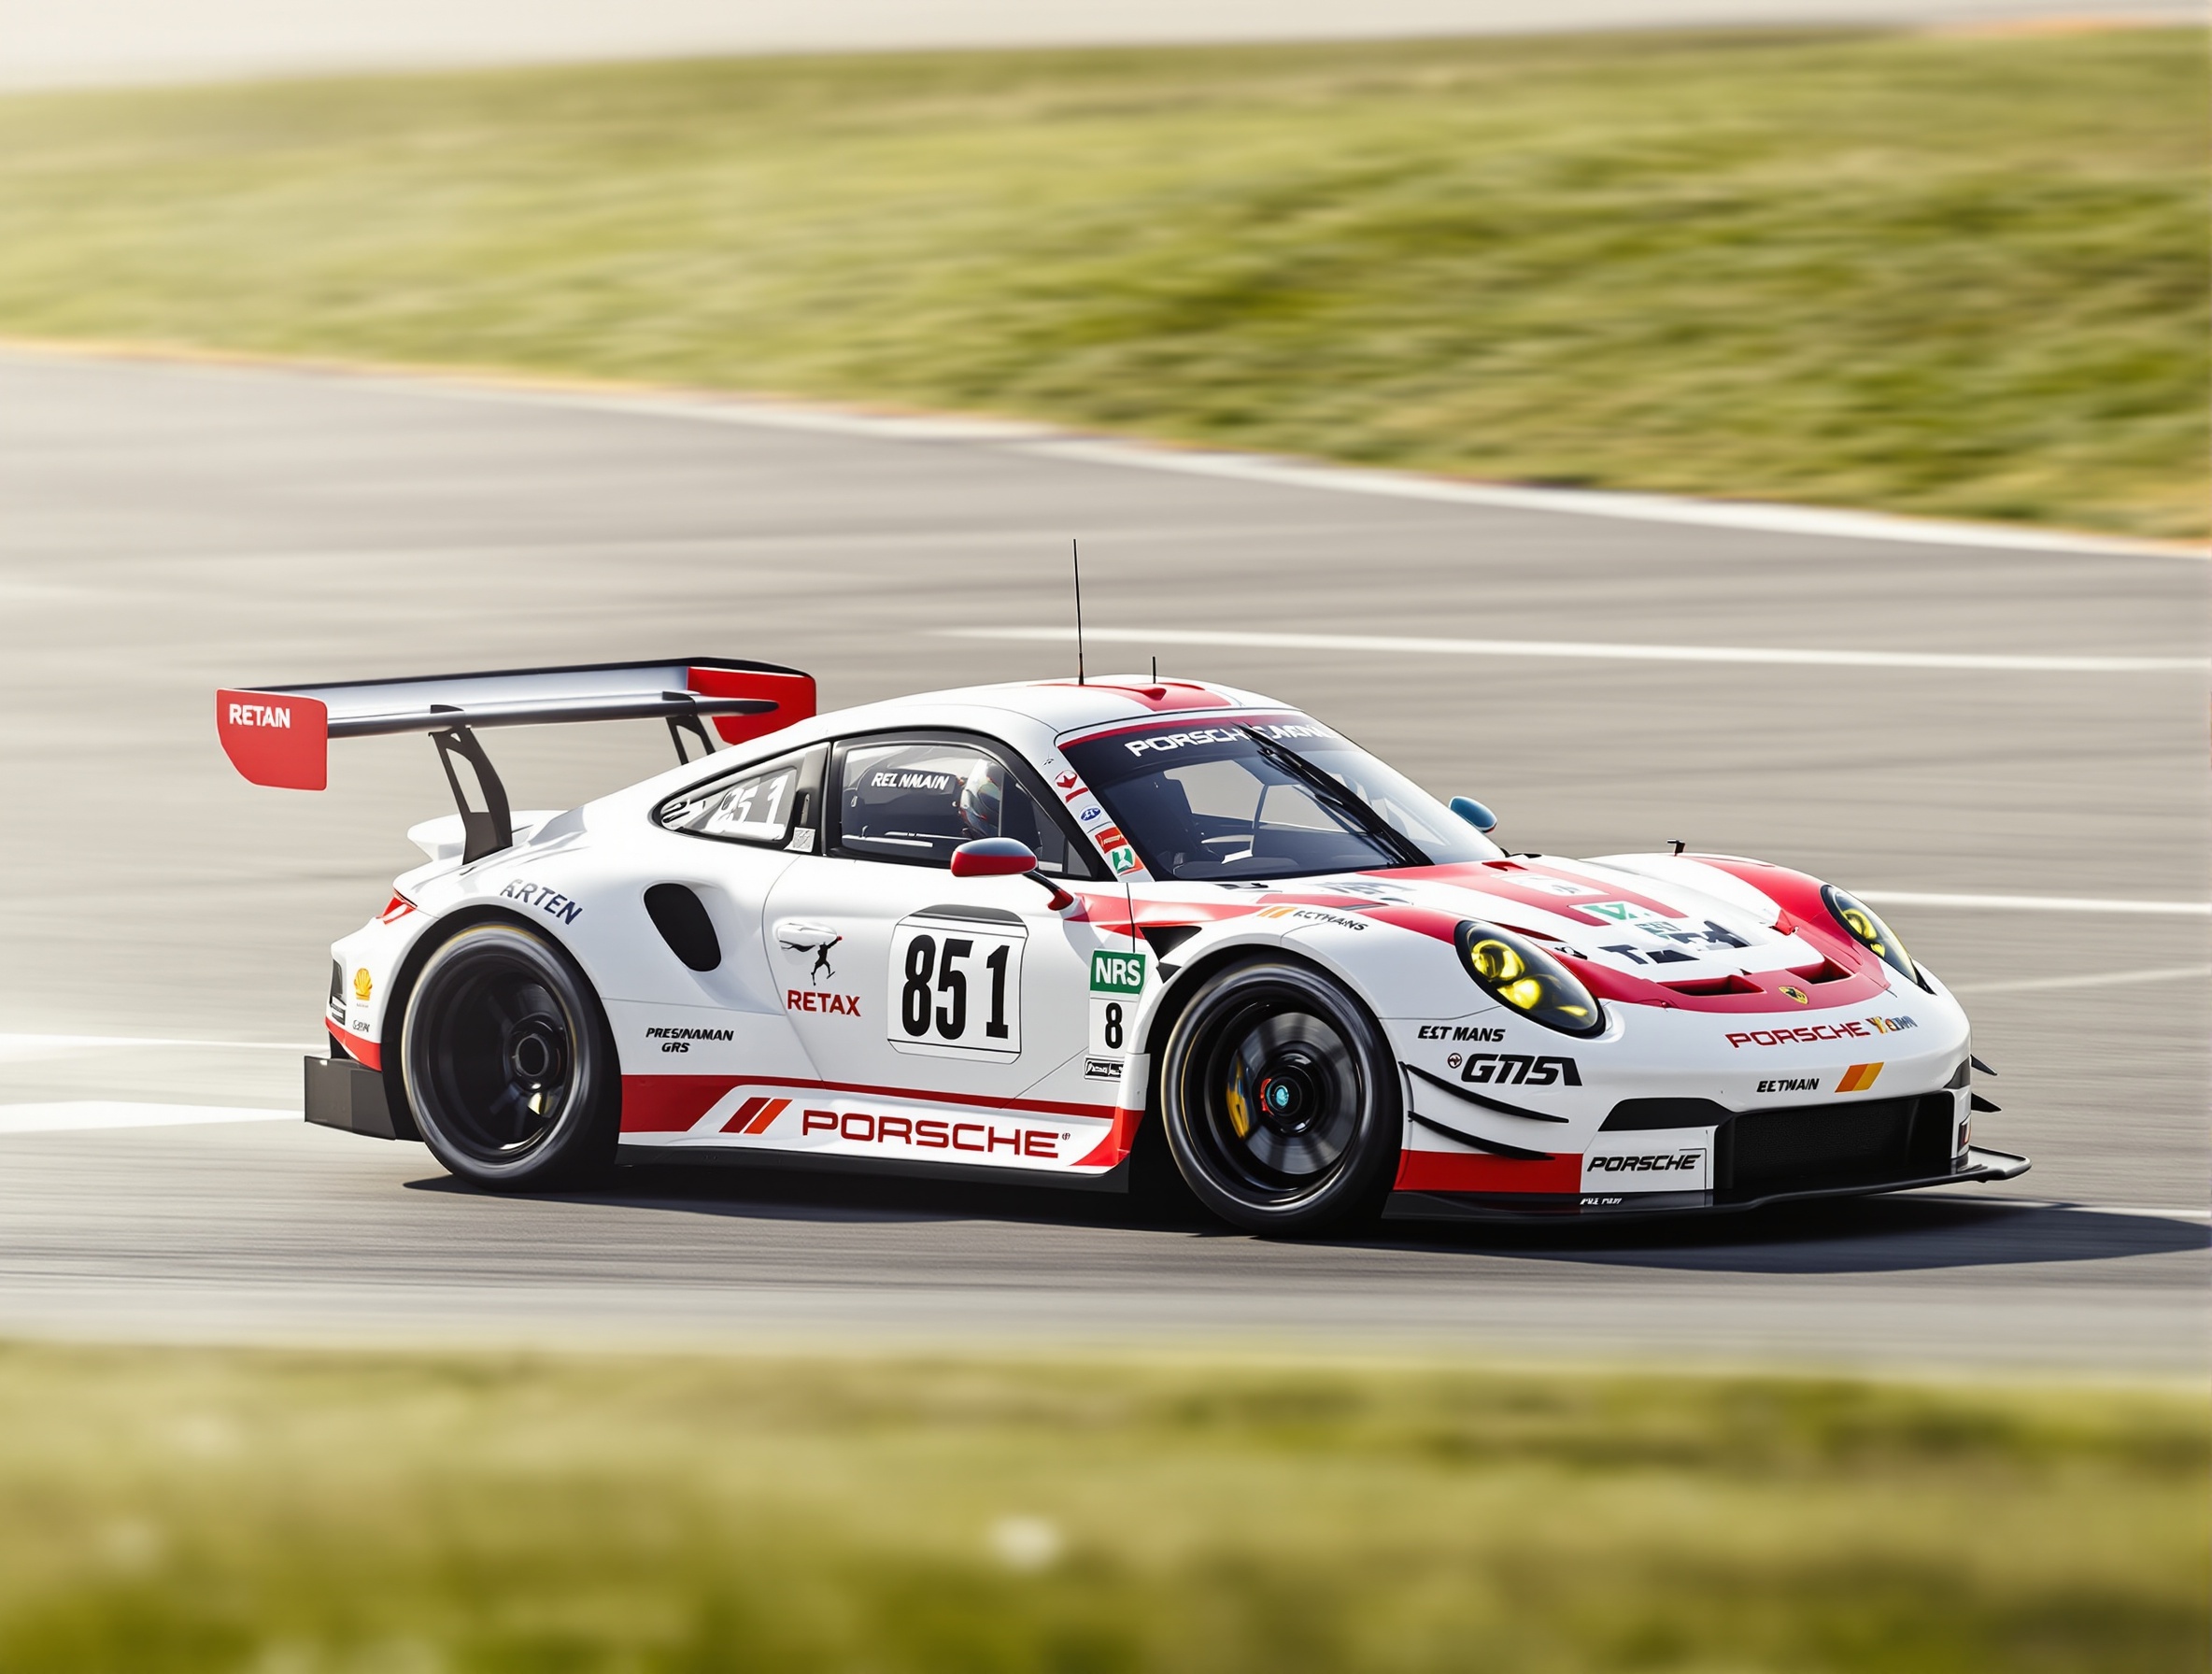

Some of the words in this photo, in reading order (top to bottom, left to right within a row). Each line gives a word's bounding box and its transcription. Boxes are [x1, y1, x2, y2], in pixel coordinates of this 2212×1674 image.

[1095, 957, 1141, 986] NRS
[901, 933, 1011, 1041] 851
[787, 989, 861, 1017] RETAX
[1104, 1001, 1123, 1050] 8
[1453, 1026, 1506, 1043] MANS
[1724, 1021, 1871, 1048] PORSCHE
[661, 1042, 690, 1054] GRS
[801, 1109, 1060, 1159] PORSCHE
[1586, 1154, 1702, 1172] PORSCHE
